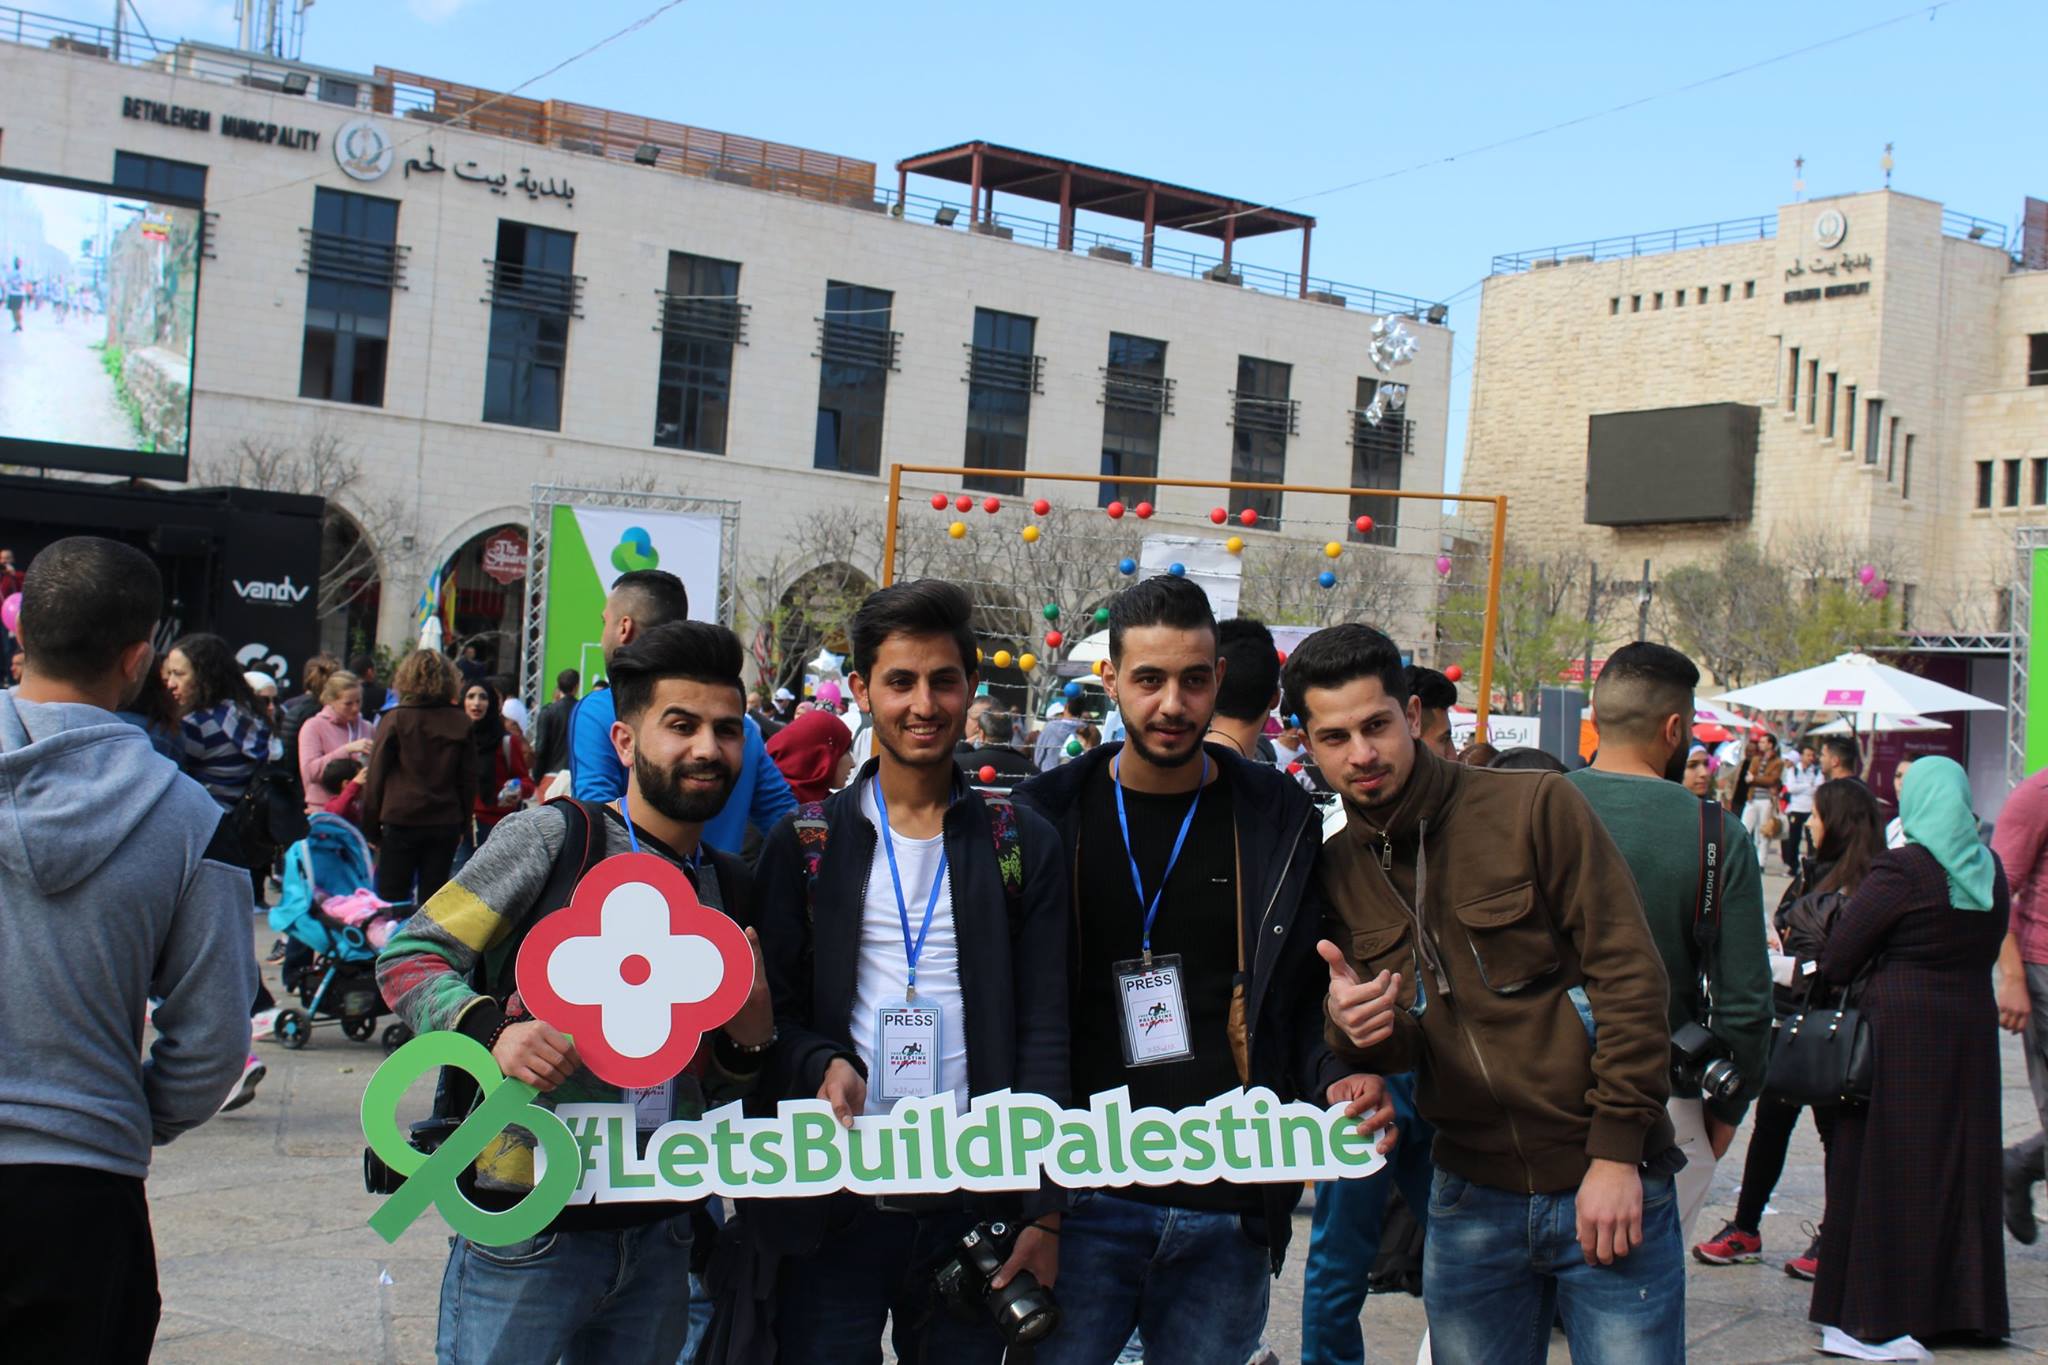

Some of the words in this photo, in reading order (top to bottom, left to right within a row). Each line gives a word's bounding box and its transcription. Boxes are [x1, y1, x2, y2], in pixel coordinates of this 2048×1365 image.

[123, 96, 211, 132] BETHLEHEM
[220, 113, 321, 151] MUNICIPALITY
[404, 145, 445, 179] لحم
[453, 161, 507, 196] بيت
[515, 167, 575, 208] بلدية
[1492, 728, 1528, 743] اركض
[1707, 843, 1717, 866] EOS
[1703, 870, 1715, 915] DIGITAL
[1126, 974, 1172, 992] PRESS
[885, 1014, 933, 1027] PRESS
[566, 1100, 1375, 1190] #LetsBuildPalestine
